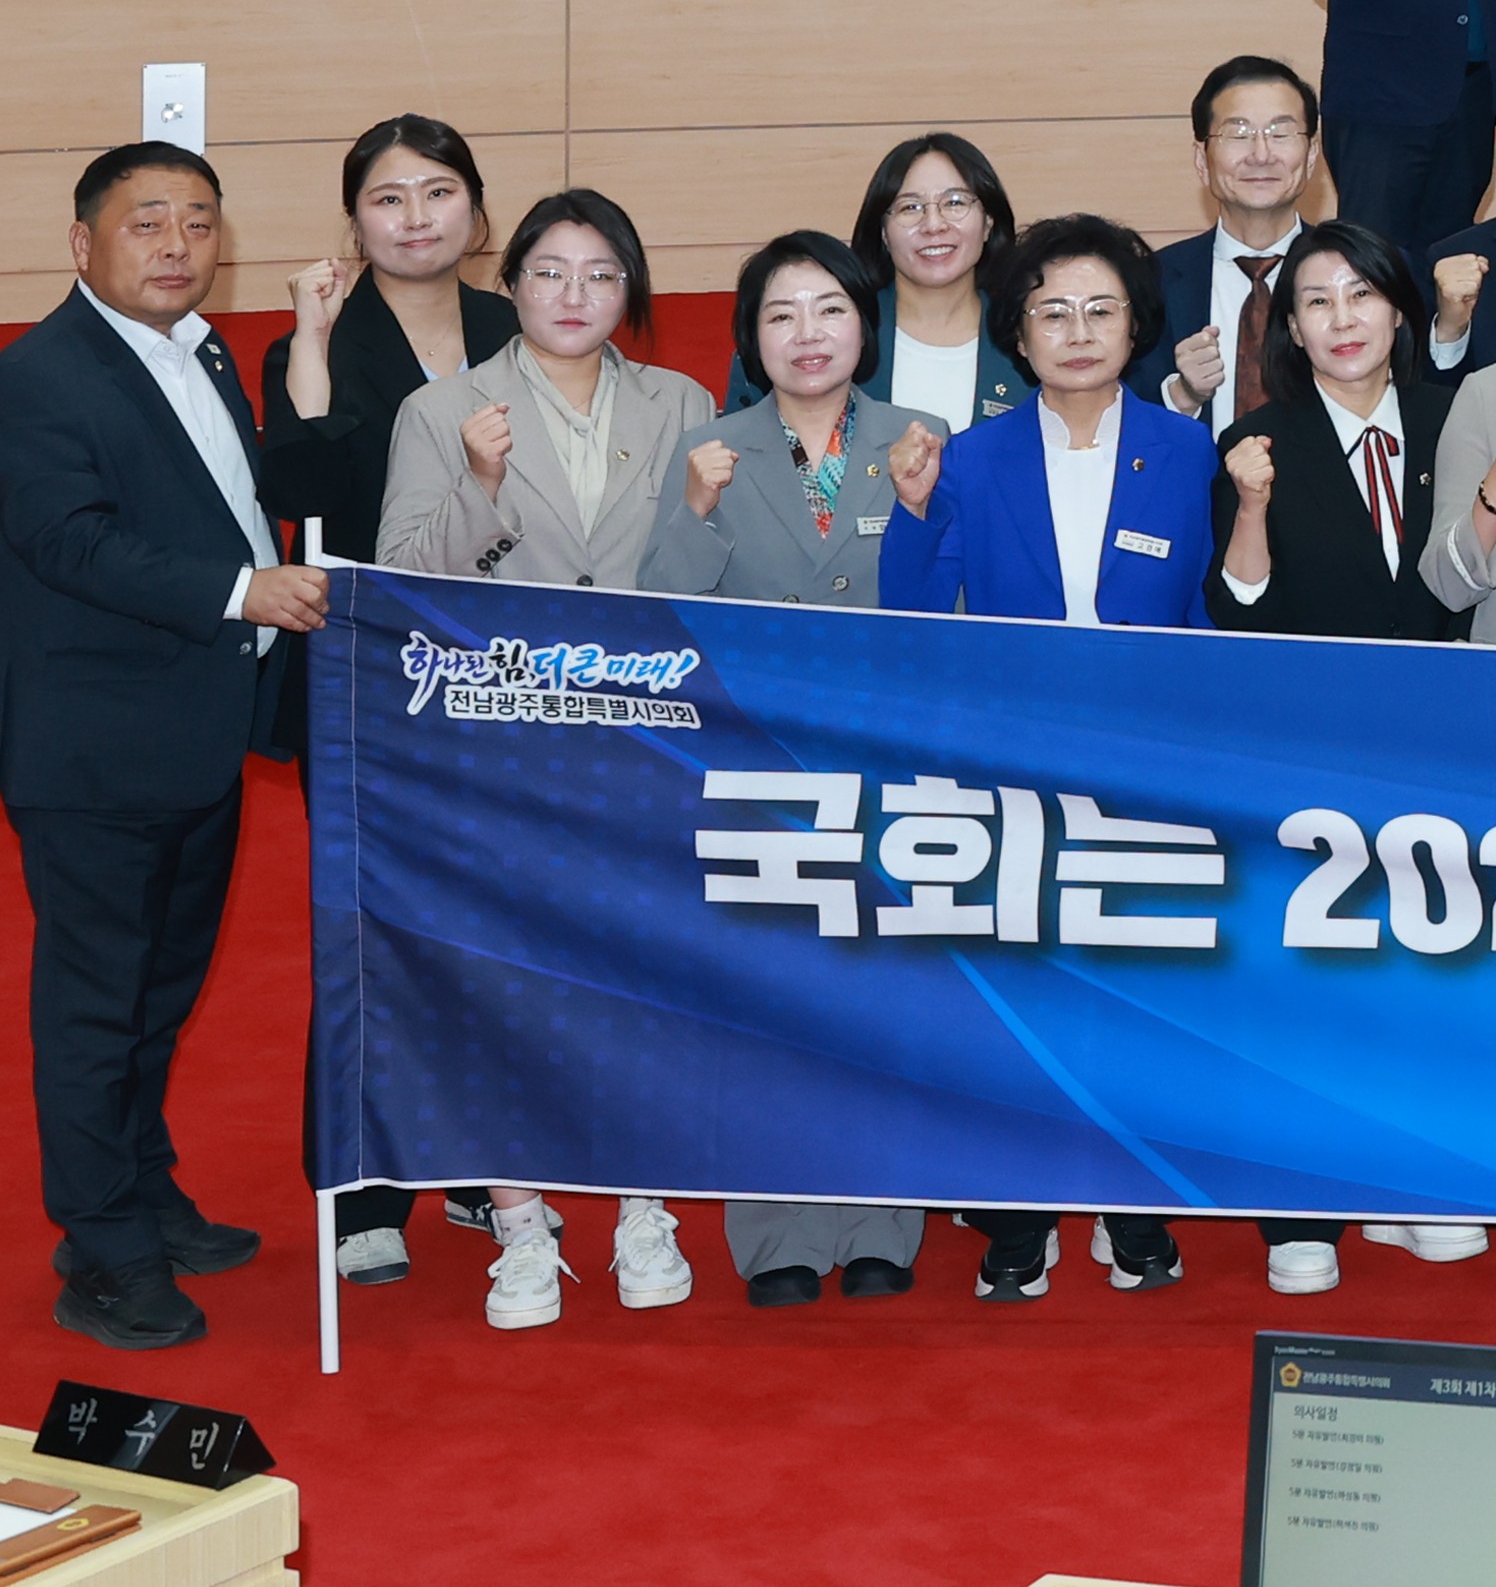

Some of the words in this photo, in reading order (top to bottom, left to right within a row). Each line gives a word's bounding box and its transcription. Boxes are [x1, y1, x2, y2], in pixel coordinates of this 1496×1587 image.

[407, 636, 490, 707] 하나된
[533, 648, 567, 689] 더
[568, 648, 601, 681] 큰
[606, 654, 694, 688] 미래!
[449, 688, 697, 724] 전남광주통합특별시의회
[695, 769, 1226, 948] 국회는
